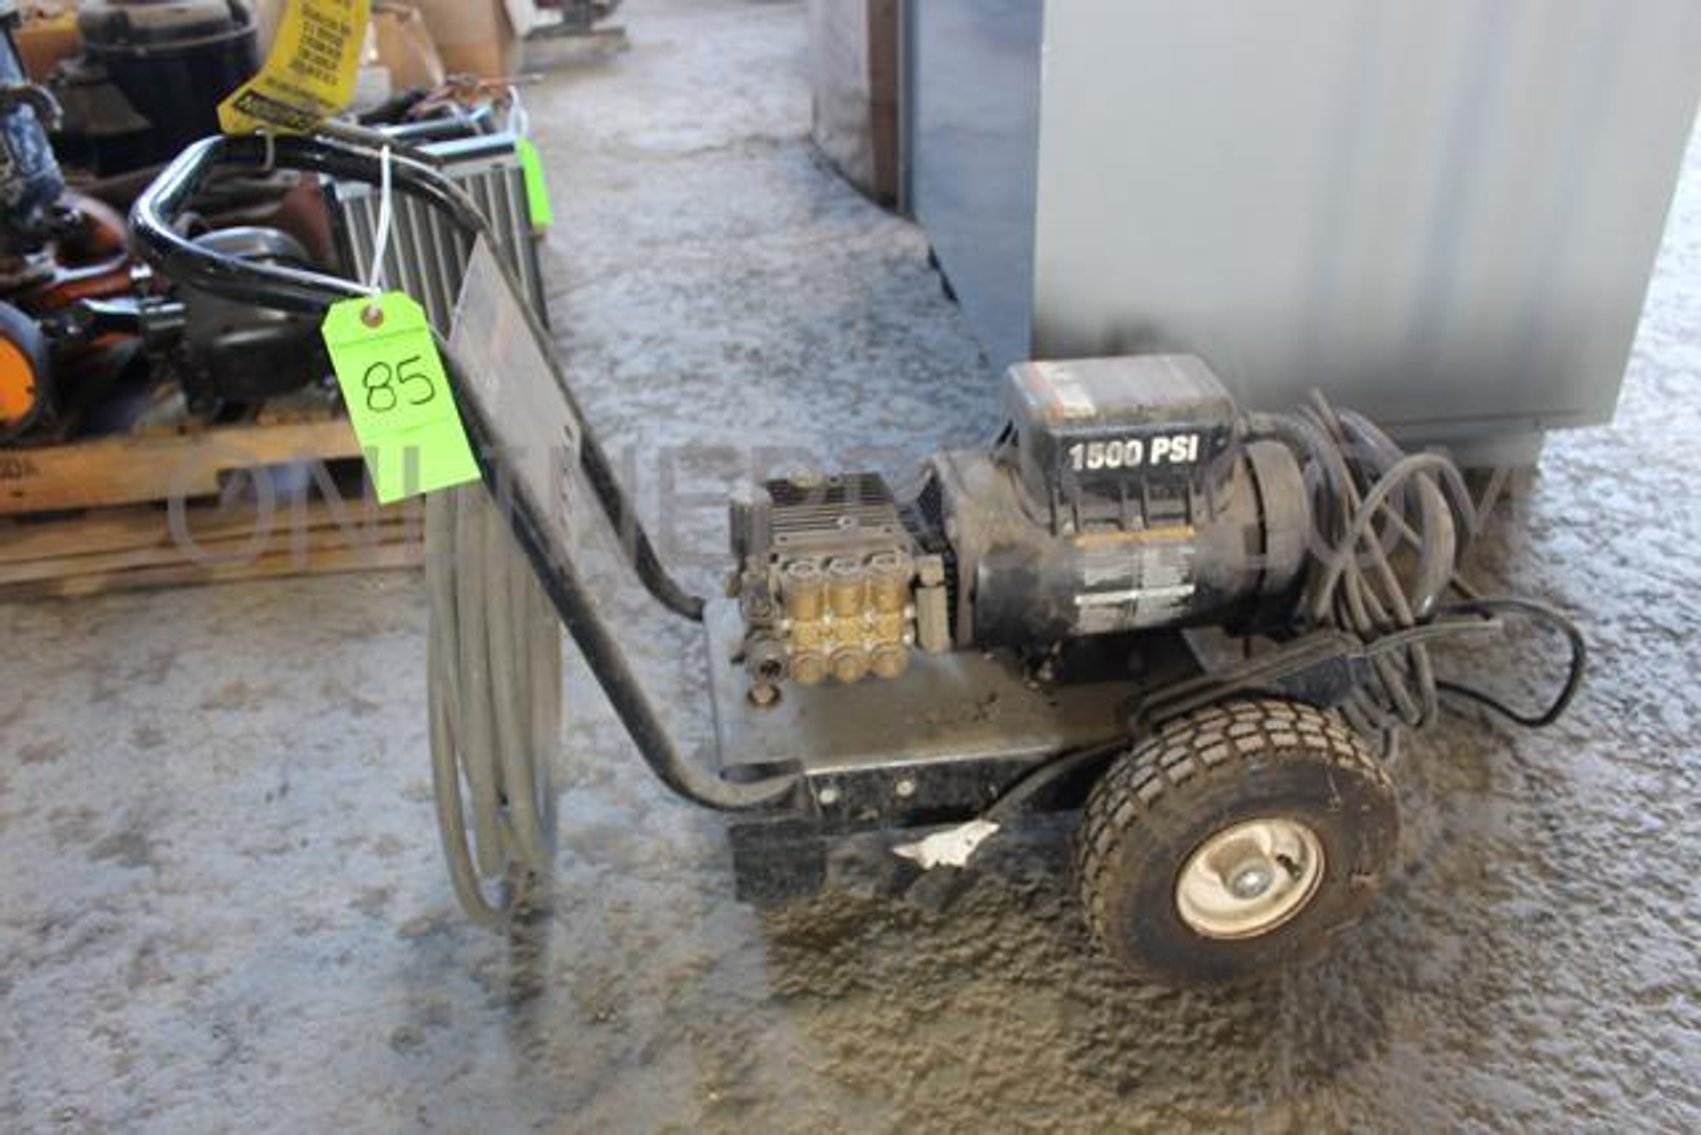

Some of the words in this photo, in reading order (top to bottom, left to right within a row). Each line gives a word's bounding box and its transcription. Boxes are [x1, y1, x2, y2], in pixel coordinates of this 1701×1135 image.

[362, 355, 435, 412] 85
[1068, 439, 1143, 472] 1500
[1150, 433, 1198, 465] PSI
